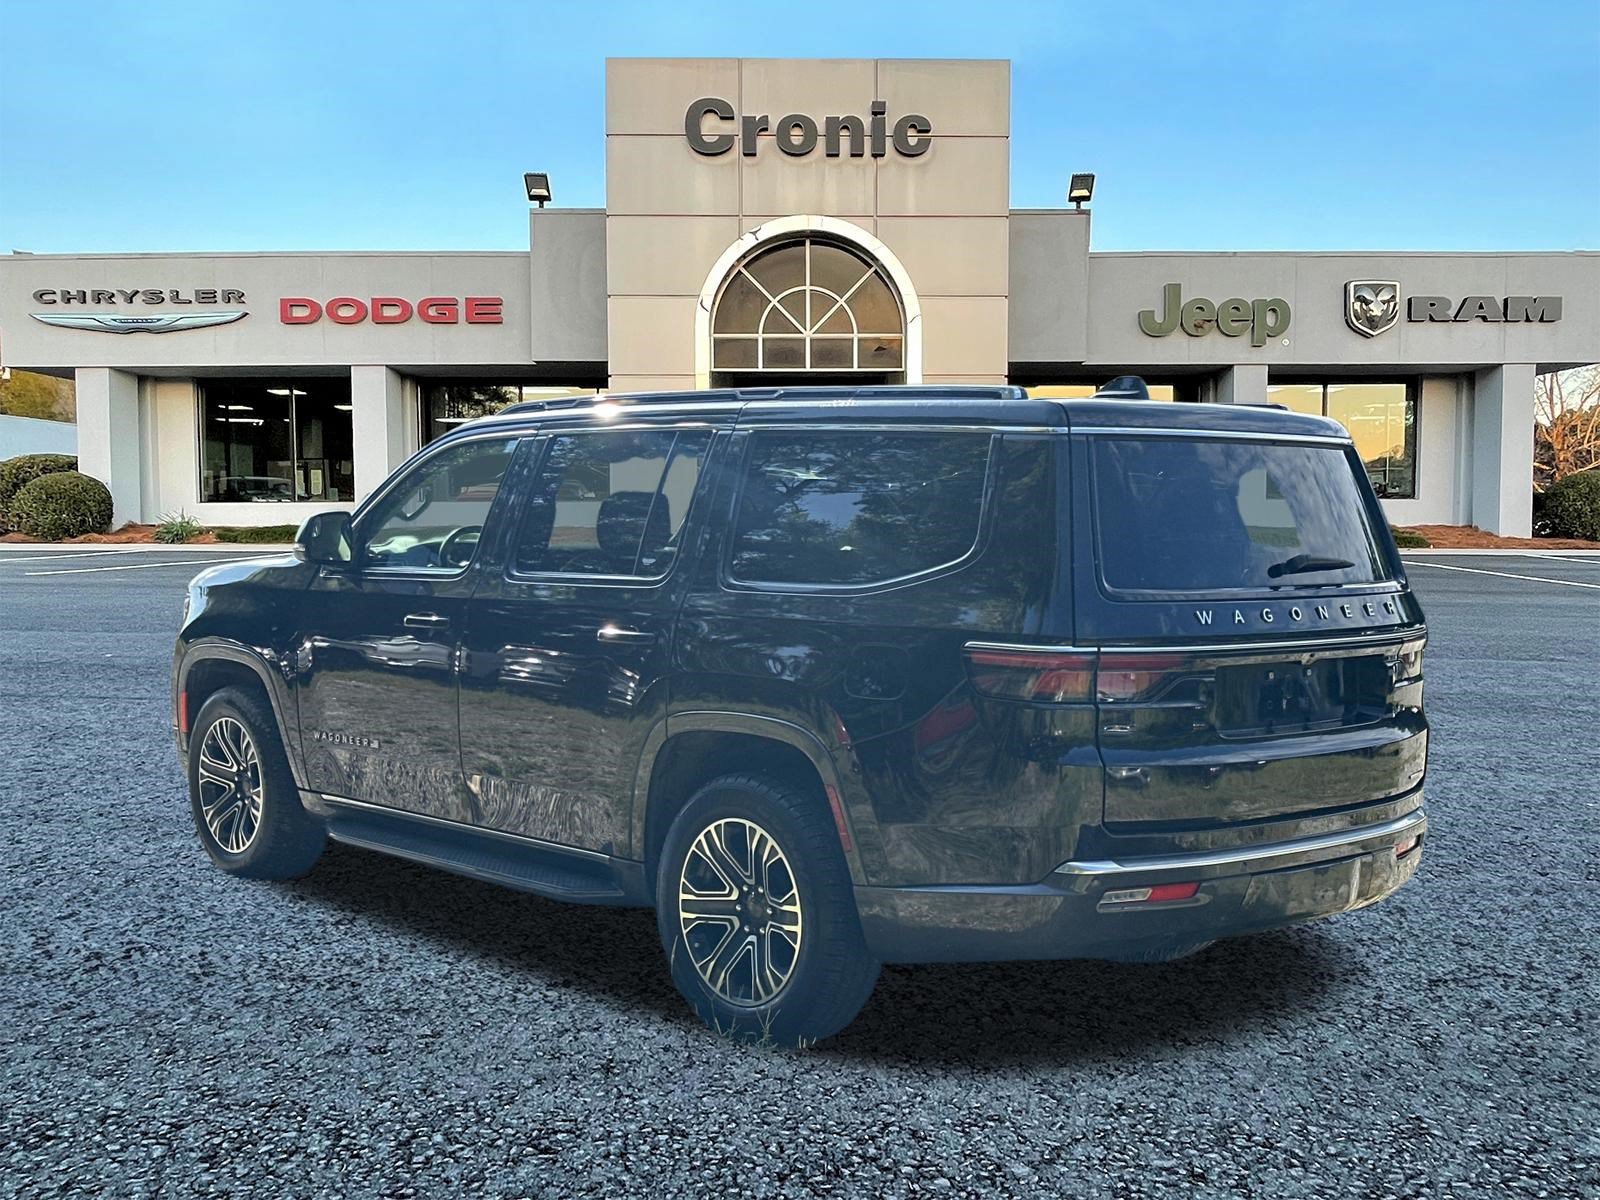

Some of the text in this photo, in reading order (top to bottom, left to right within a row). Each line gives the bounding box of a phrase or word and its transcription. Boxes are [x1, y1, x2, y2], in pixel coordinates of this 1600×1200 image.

[684, 97, 932, 157] Cronic
[32, 288, 246, 305] CHRYSLER
[1407, 296, 1563, 323] RAM
[279, 297, 503, 325] DODGE
[1138, 283, 1292, 347] Jeep
[1196, 601, 1394, 625] WAGONEER
[313, 730, 369, 747] WAGONEER
